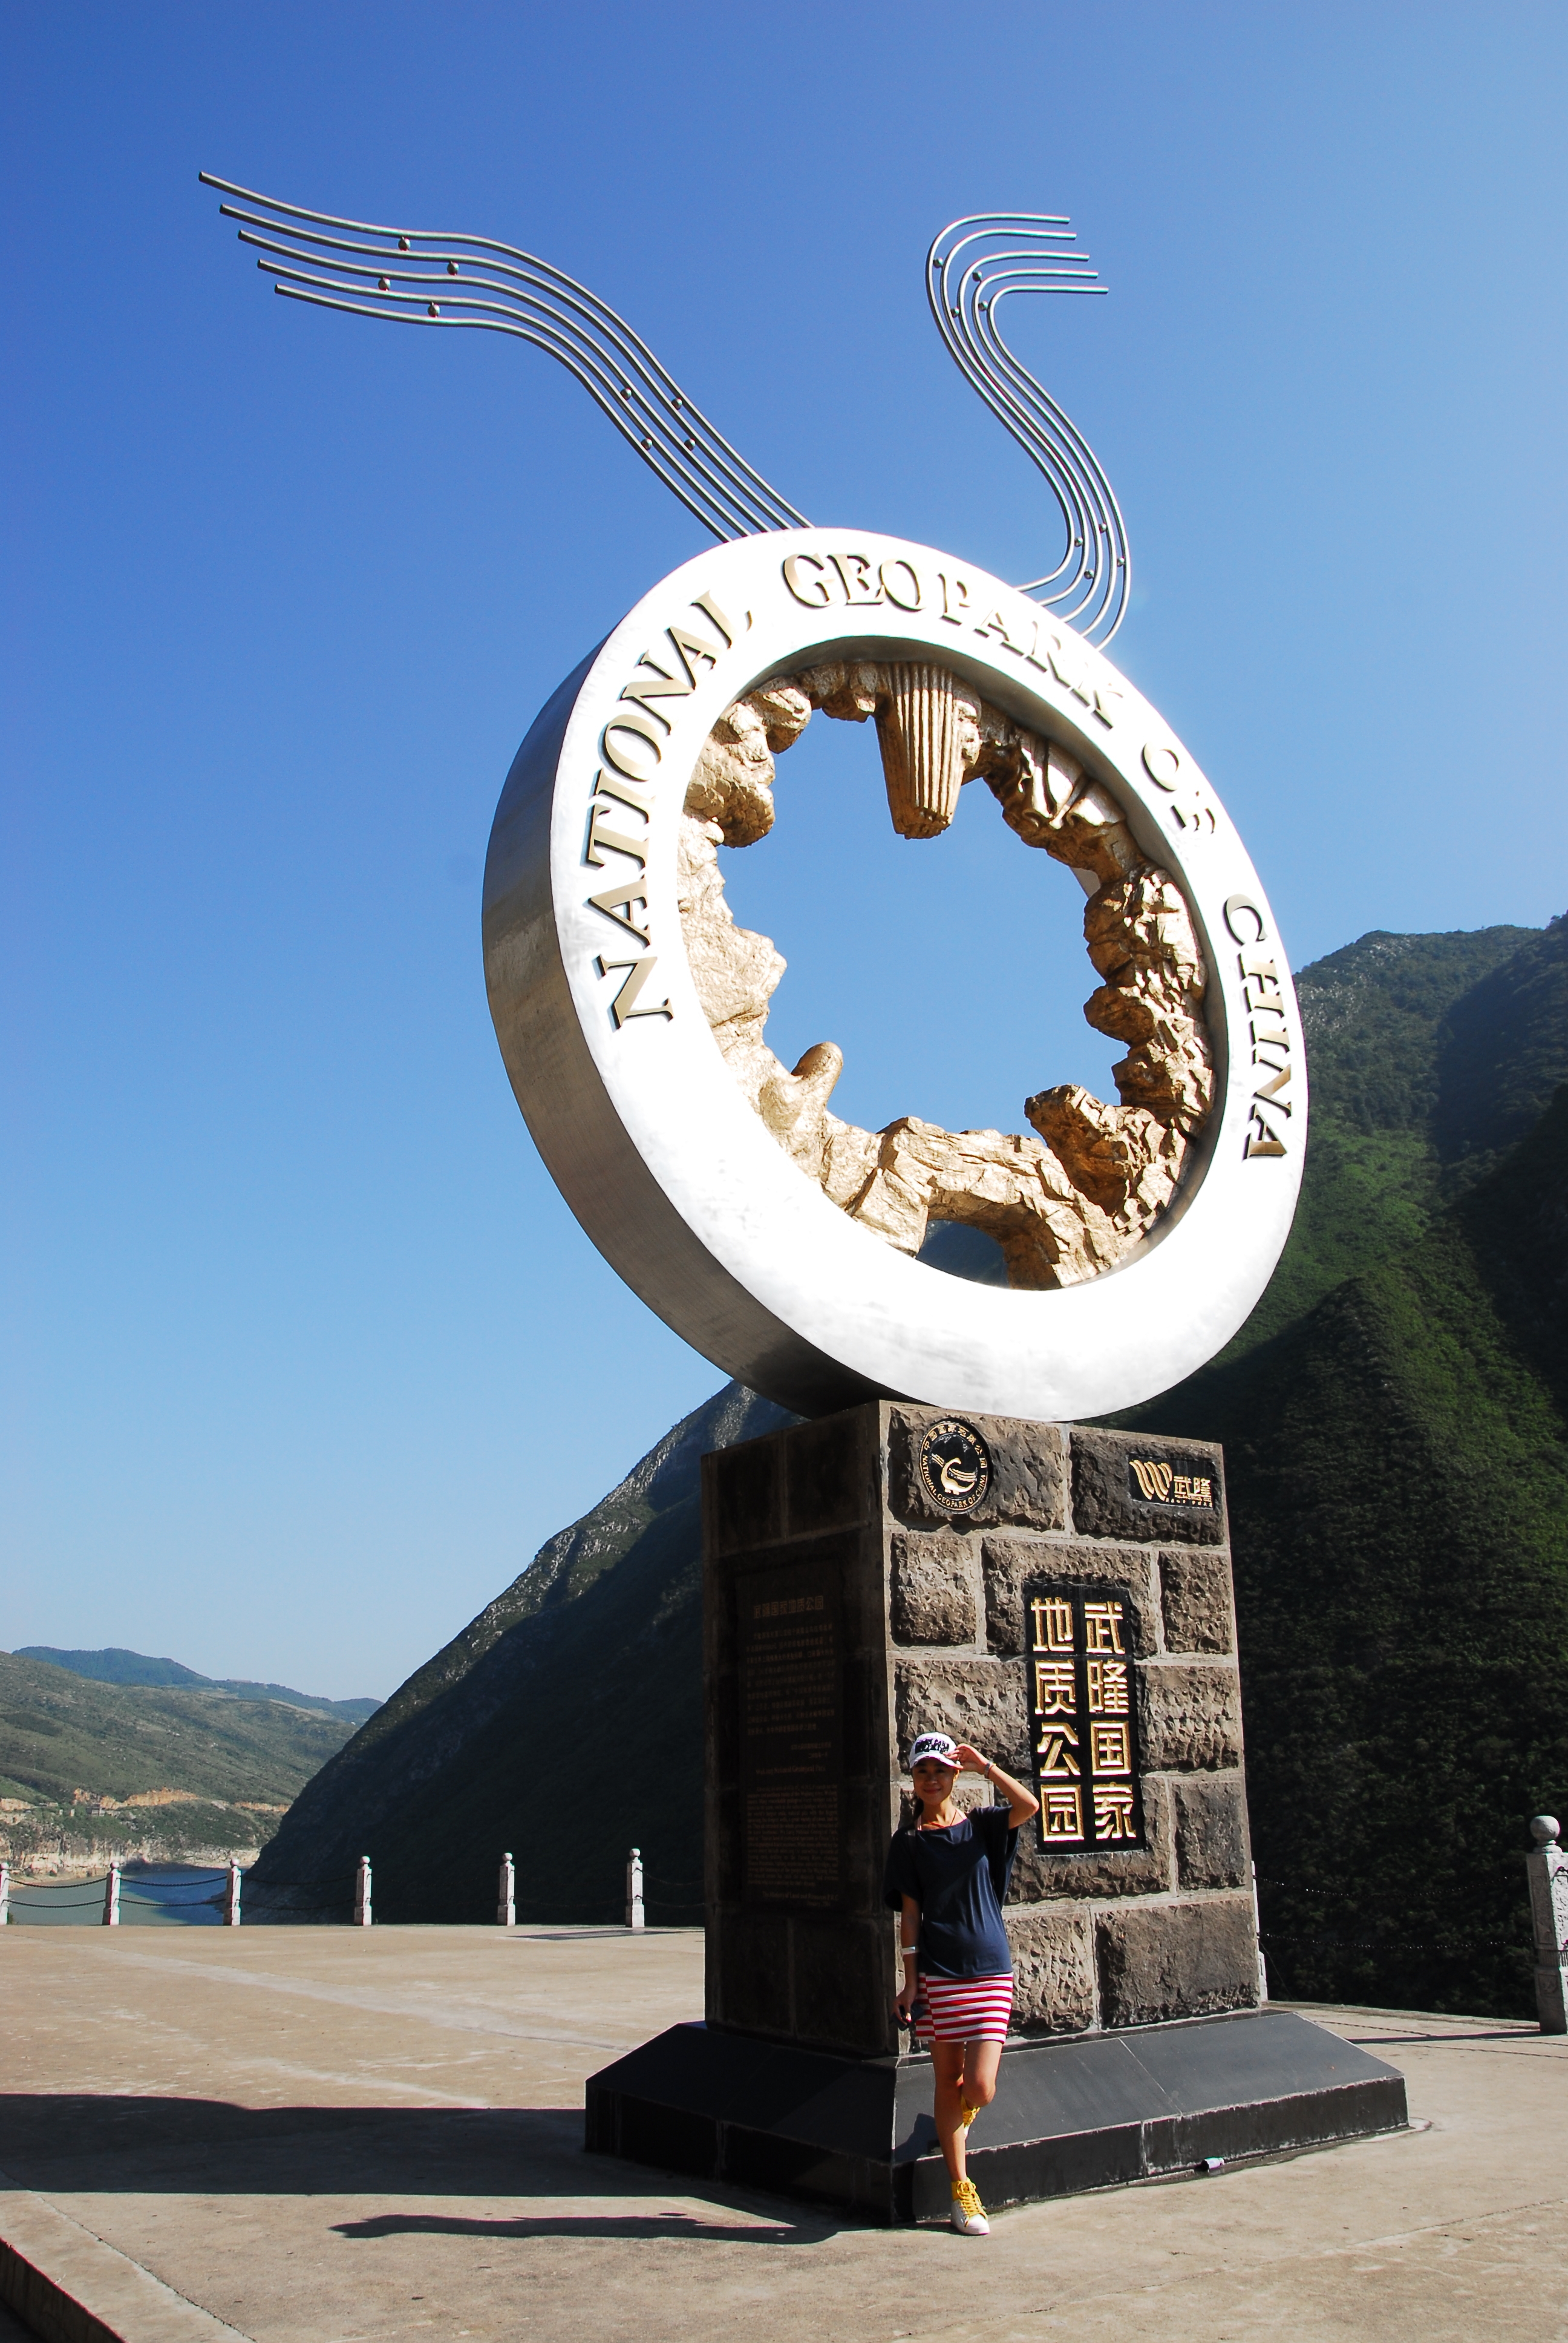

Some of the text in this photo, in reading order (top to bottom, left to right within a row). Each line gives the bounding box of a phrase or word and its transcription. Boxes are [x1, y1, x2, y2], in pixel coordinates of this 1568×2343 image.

[780, 553, 1124, 730] GEOPARK
[1142, 740, 1217, 835] OF
[1222, 893, 1293, 1160] CHINA
[922, 1454, 986, 1508] NATIONAL GEOPARK OF CHINA
[1174, 1475, 1212, 1498] 武隆
[753, 1595, 824, 1619] 武隆国家地质公园
[1030, 1596, 1085, 1842] 地质公园
[1084, 1600, 1137, 1840] 武隆国家
